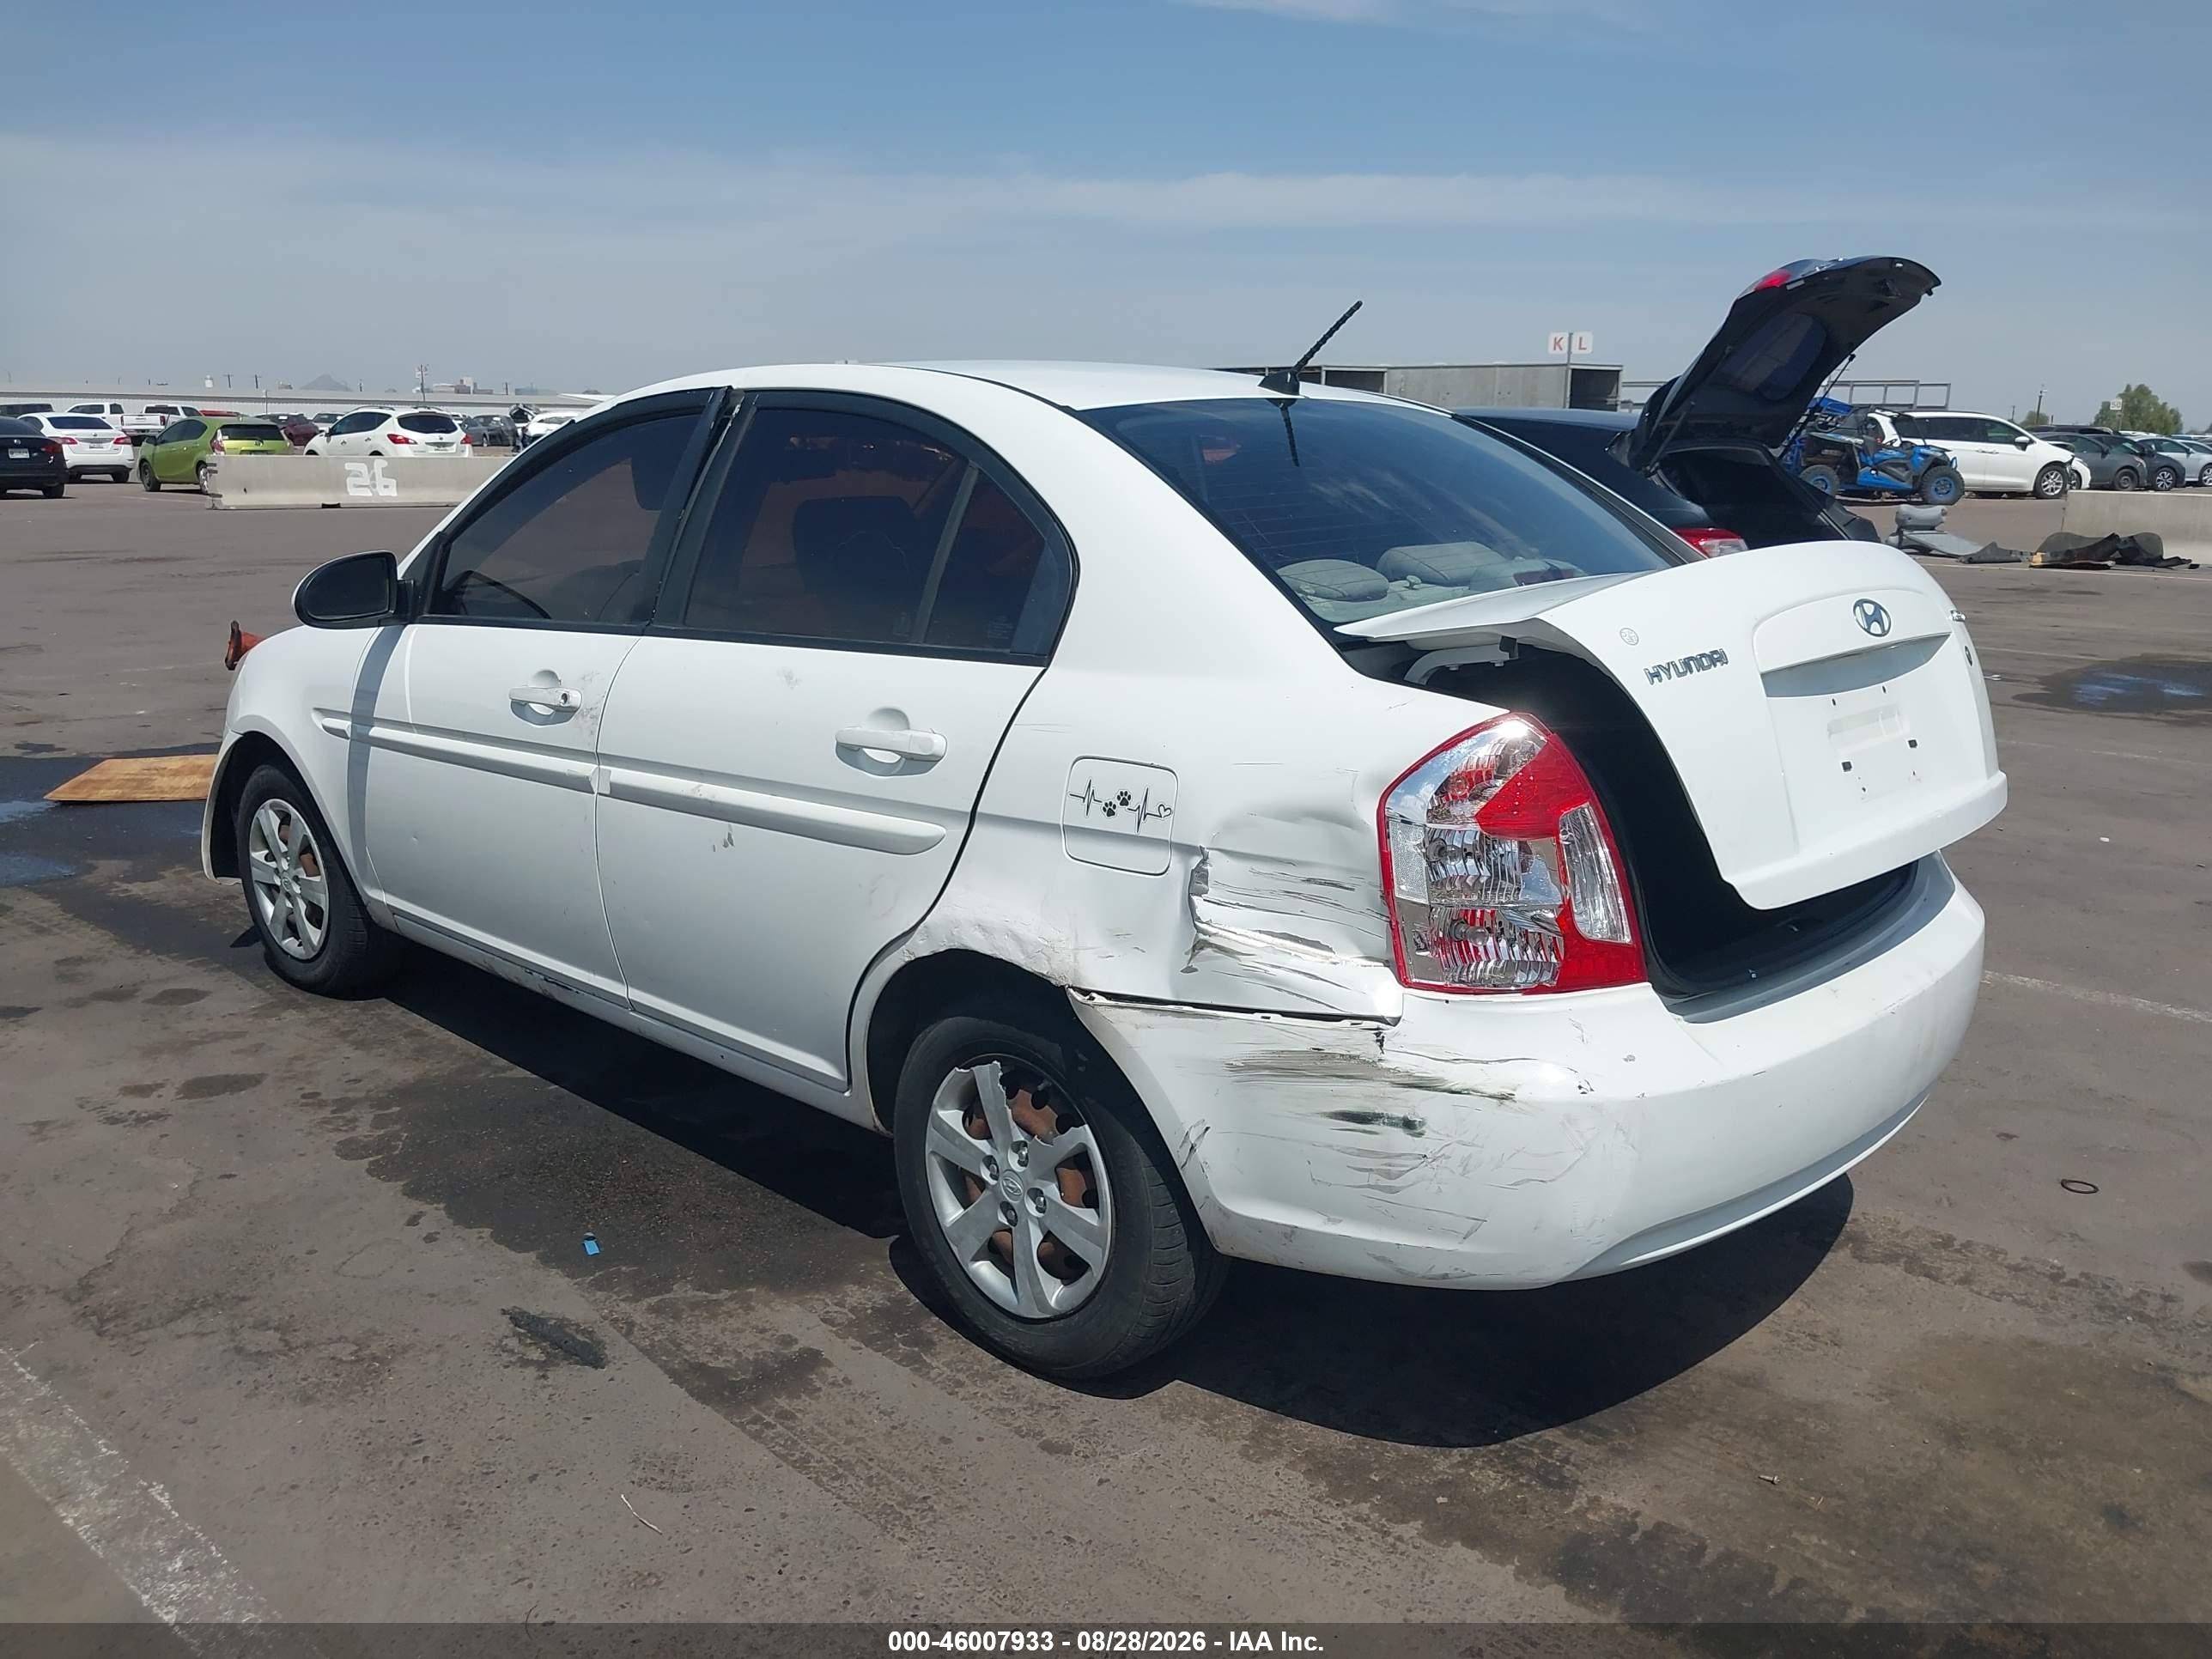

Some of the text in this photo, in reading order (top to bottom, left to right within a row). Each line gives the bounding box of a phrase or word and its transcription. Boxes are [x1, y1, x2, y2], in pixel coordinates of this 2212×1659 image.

[1553, 336, 1564, 351] K
[1577, 336, 1588, 351] L
[344, 458, 398, 496] 26
[1644, 648, 1729, 686] HYUNDAI
